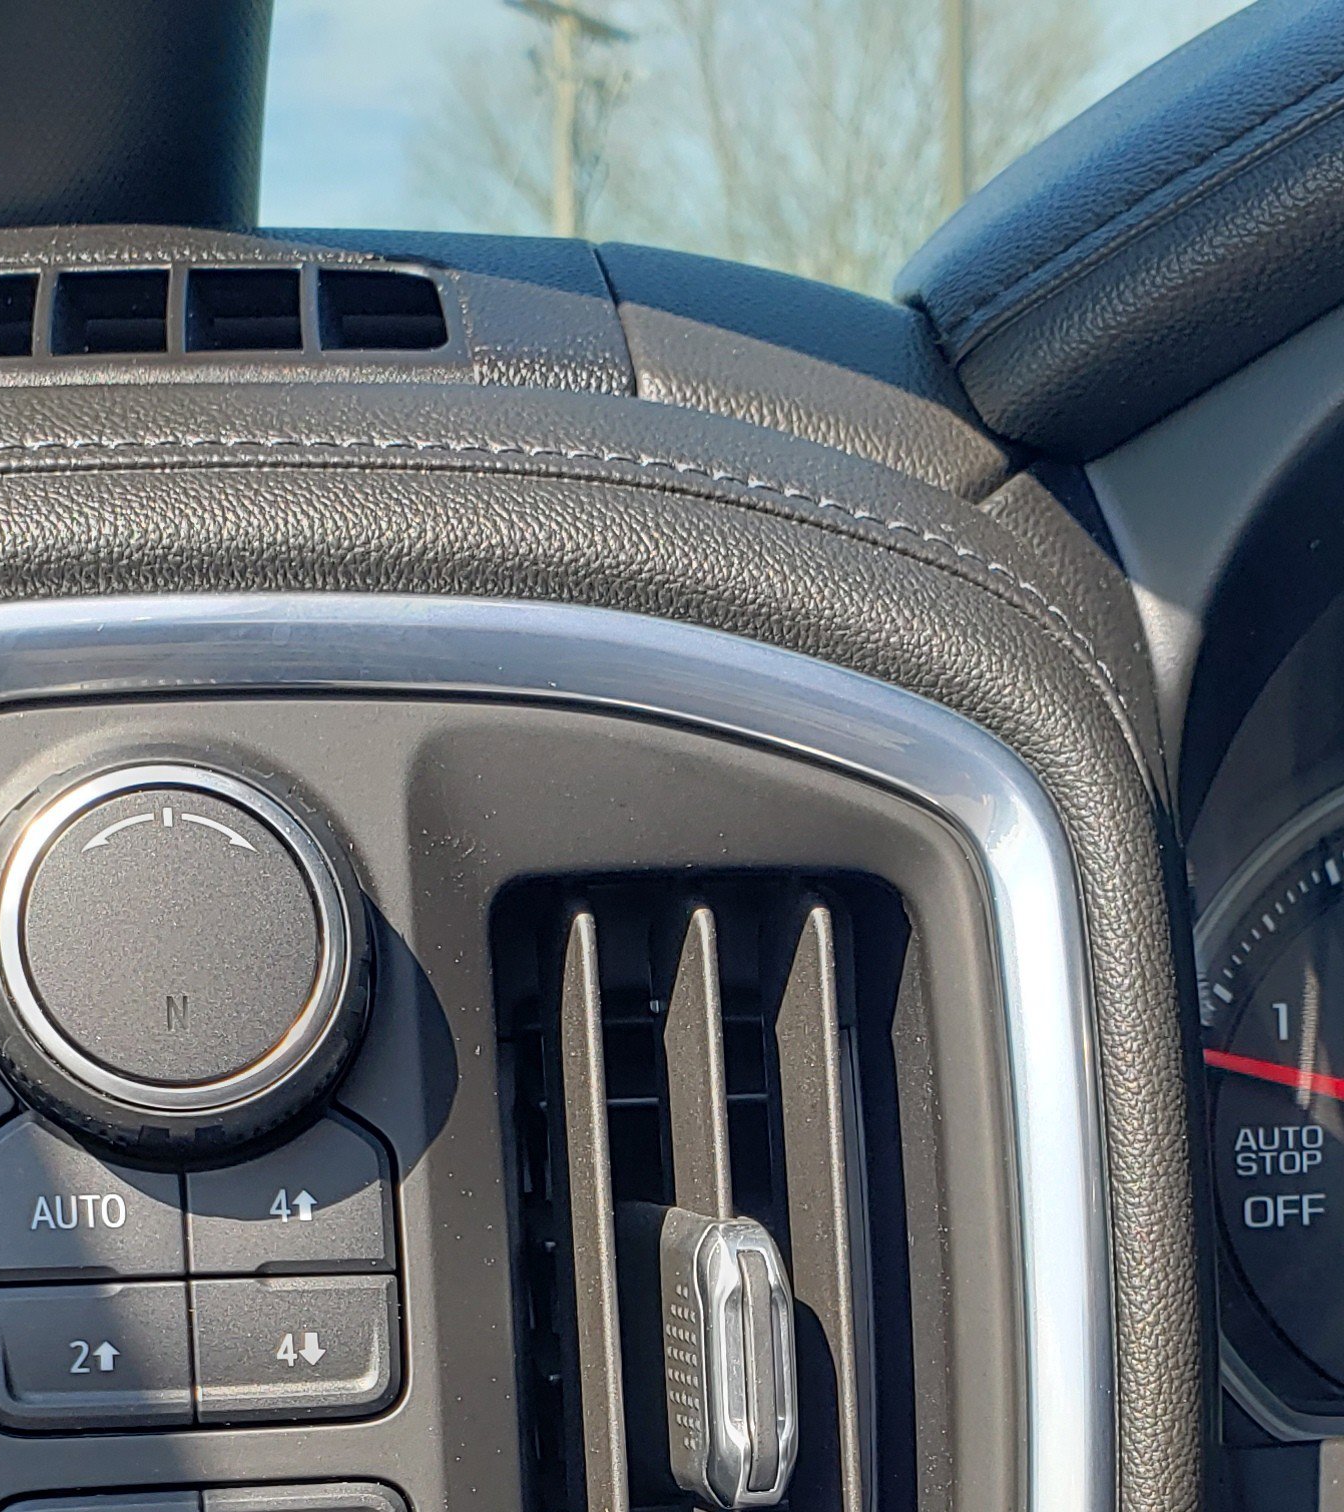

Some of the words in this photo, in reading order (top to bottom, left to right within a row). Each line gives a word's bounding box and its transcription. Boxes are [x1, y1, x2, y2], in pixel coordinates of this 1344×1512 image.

[1271, 1003, 1289, 1041] 1
[1234, 1125, 1323, 1151] AUTO
[1236, 1150, 1322, 1176] STOP
[30, 1193, 127, 1230] AUTO
[1243, 1194, 1326, 1229] OFF
